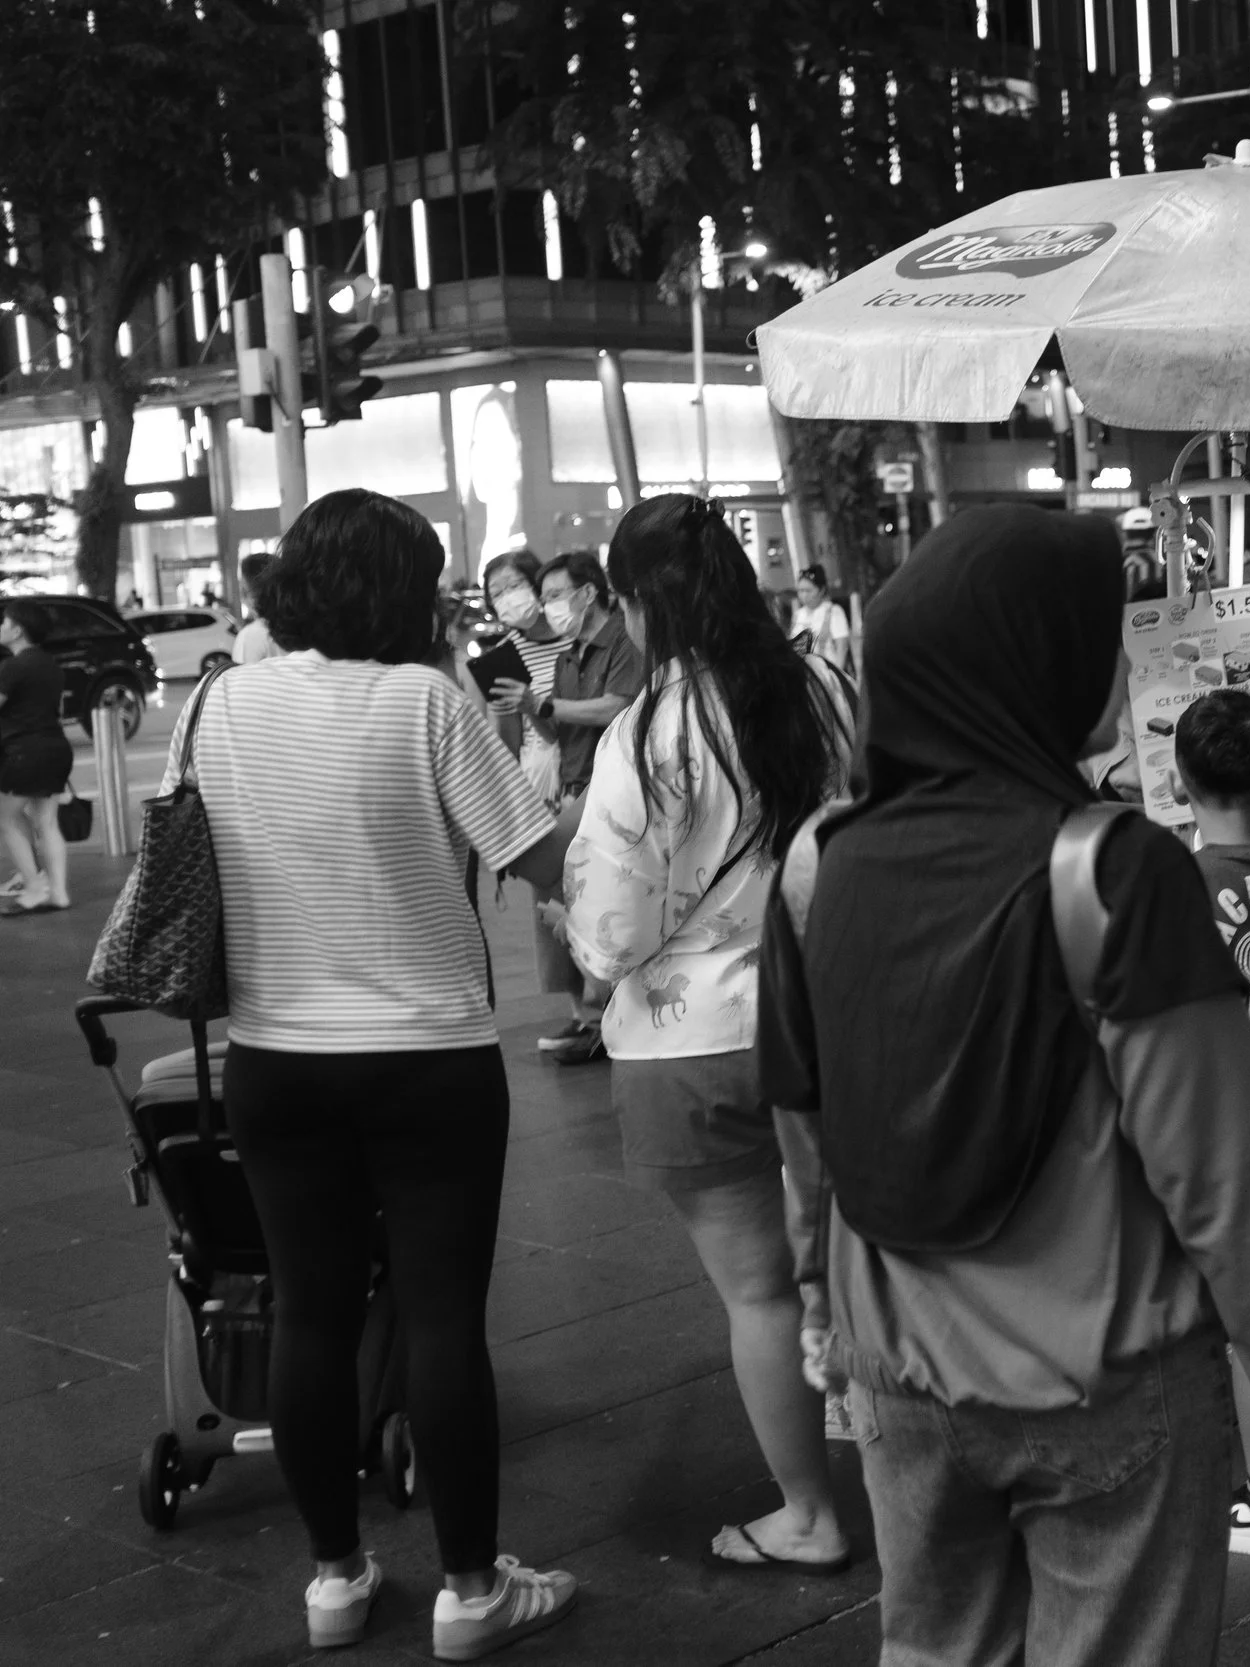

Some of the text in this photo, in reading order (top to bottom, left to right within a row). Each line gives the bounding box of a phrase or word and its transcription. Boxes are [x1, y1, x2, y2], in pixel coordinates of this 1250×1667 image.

[916, 234, 1103, 271] Magnolia
[863, 289, 1026, 307] ice cream
[1156, 697, 1171, 707] ICE
